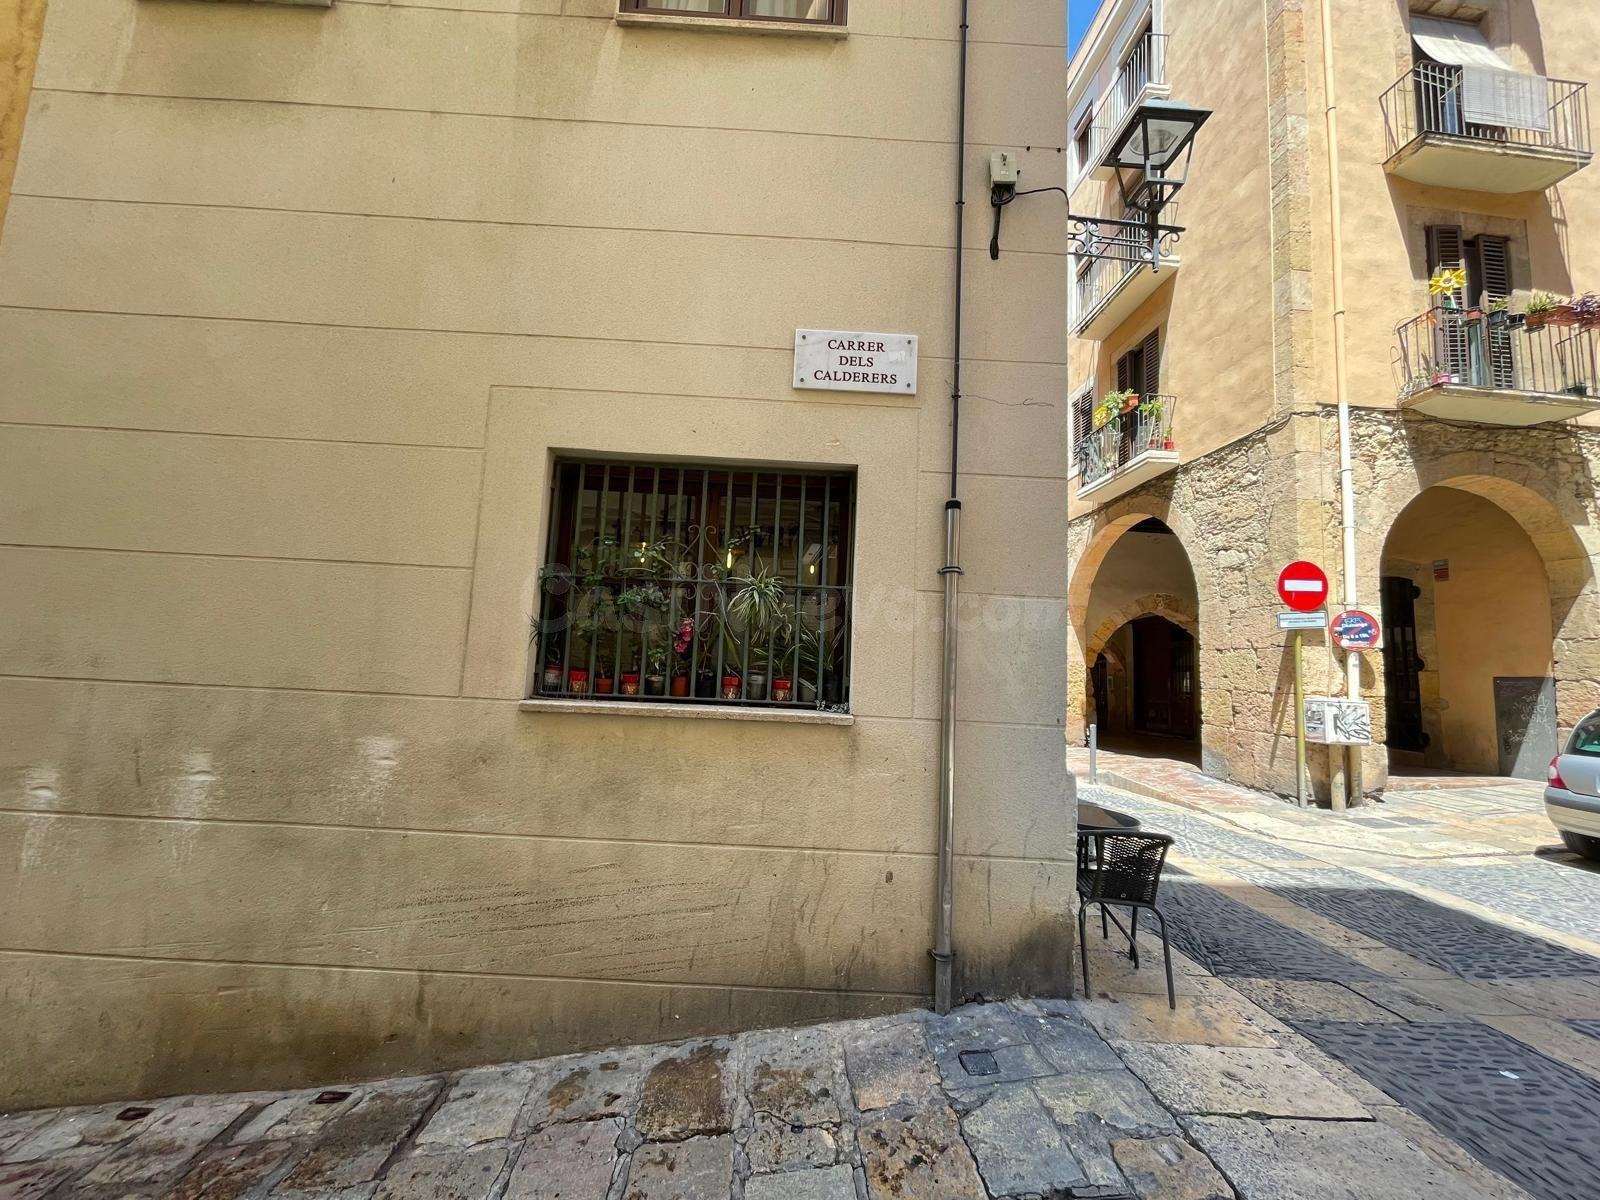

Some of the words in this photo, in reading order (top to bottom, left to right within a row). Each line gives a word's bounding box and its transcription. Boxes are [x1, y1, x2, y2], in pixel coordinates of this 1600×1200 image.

[828, 339, 885, 352] CARRER
[838, 355, 874, 367] DELS
[814, 370, 897, 385] CALDERERS
